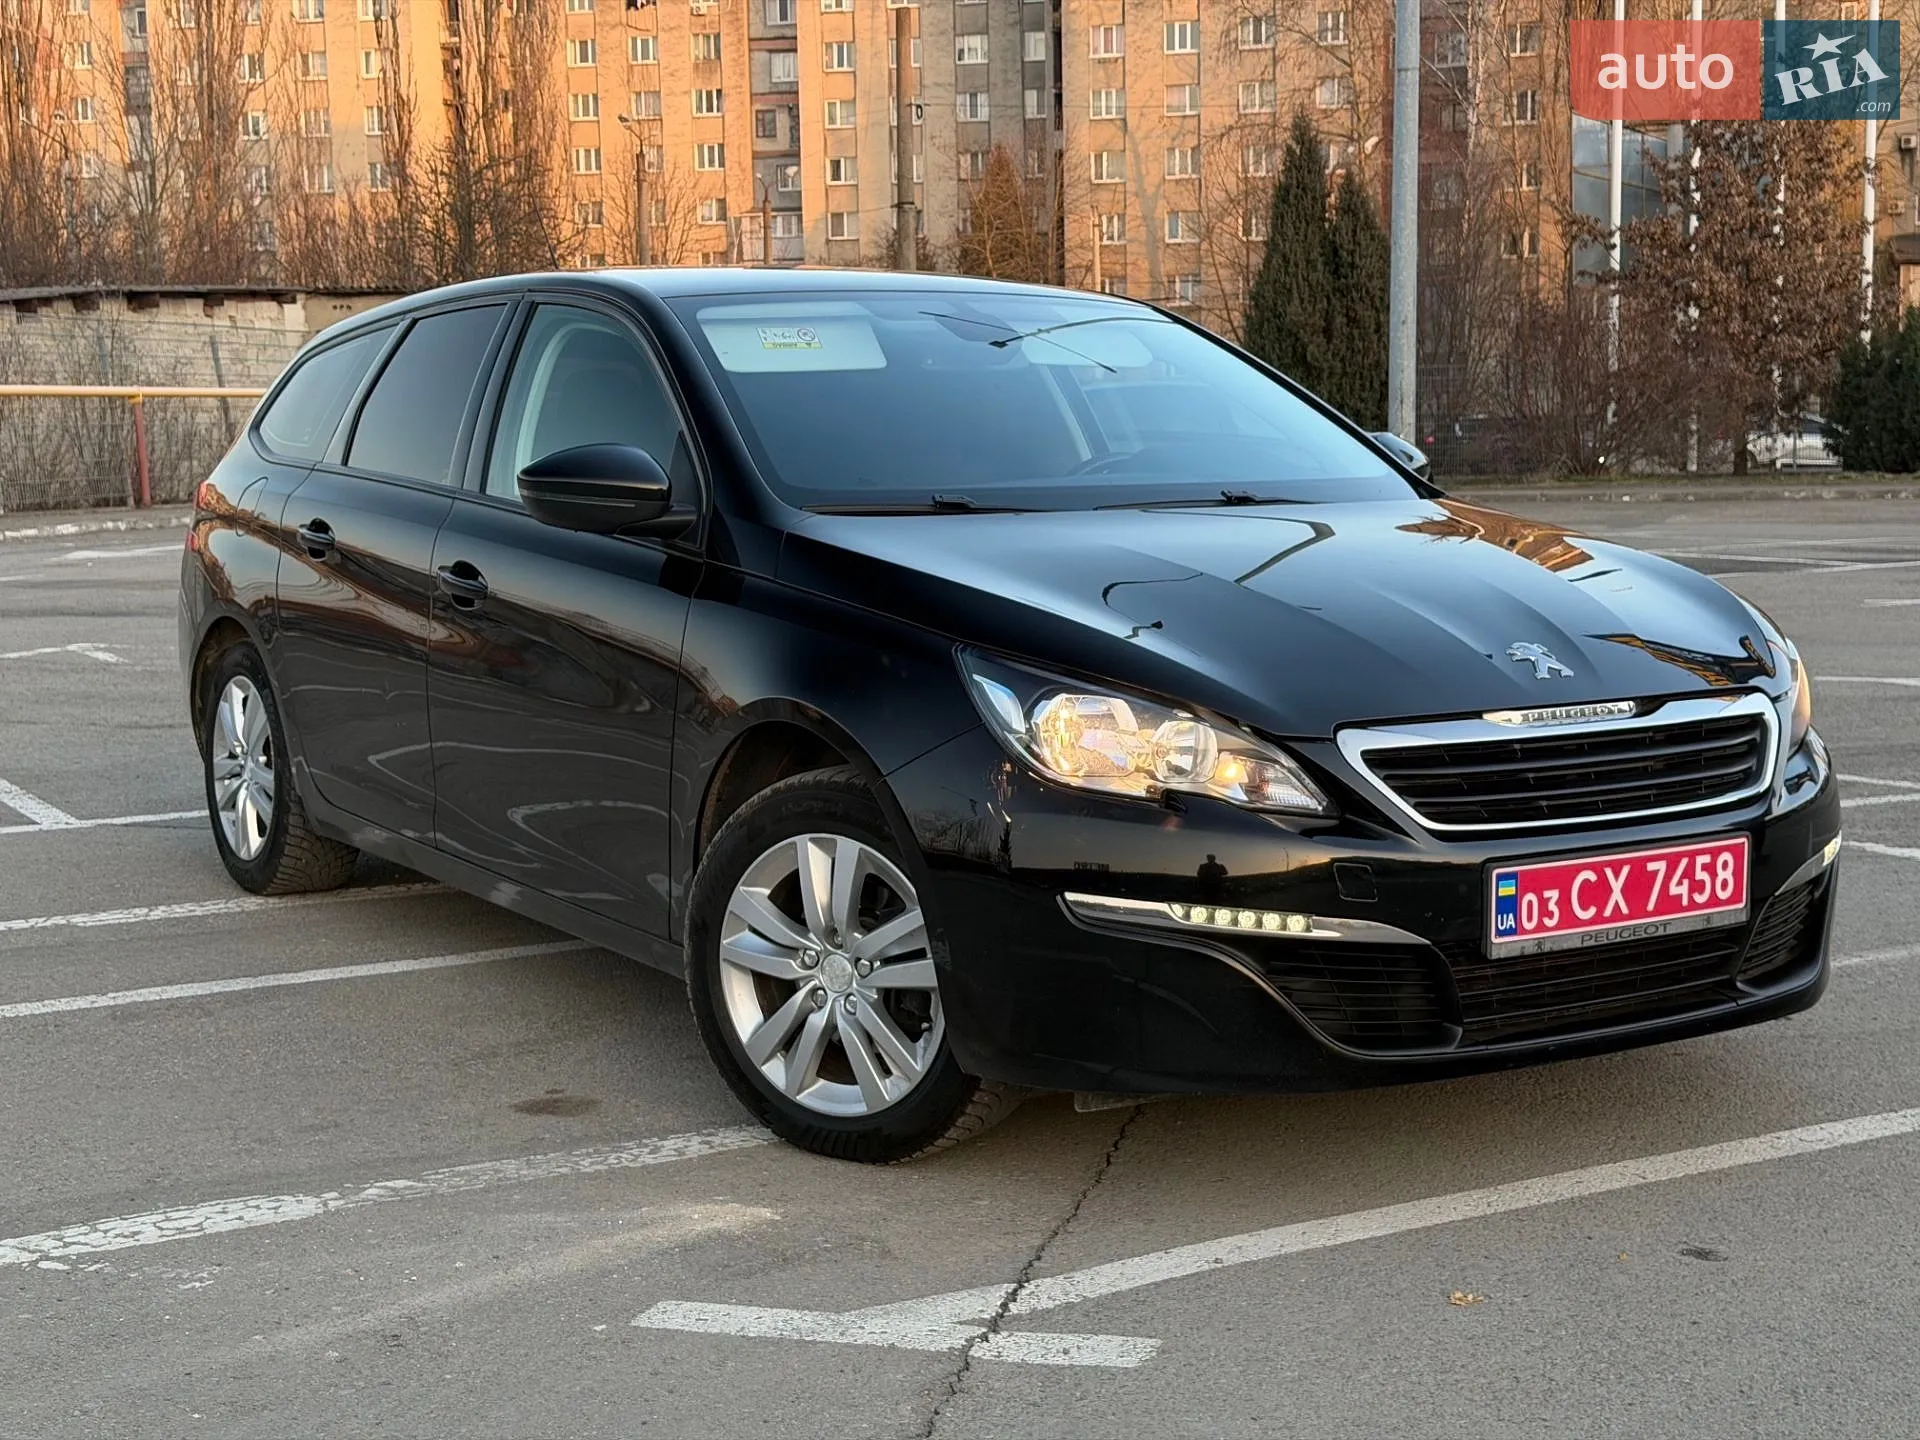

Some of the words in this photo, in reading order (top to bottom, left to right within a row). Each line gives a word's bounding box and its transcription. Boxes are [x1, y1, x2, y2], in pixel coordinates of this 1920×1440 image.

[1528, 704, 1620, 722] PEUGEOT
[1521, 889, 1560, 931] 03
[1570, 864, 1631, 920] CX
[1646, 851, 1735, 912] 7458
[1497, 913, 1516, 931] UA
[1580, 922, 1672, 945] PEUGEOT
